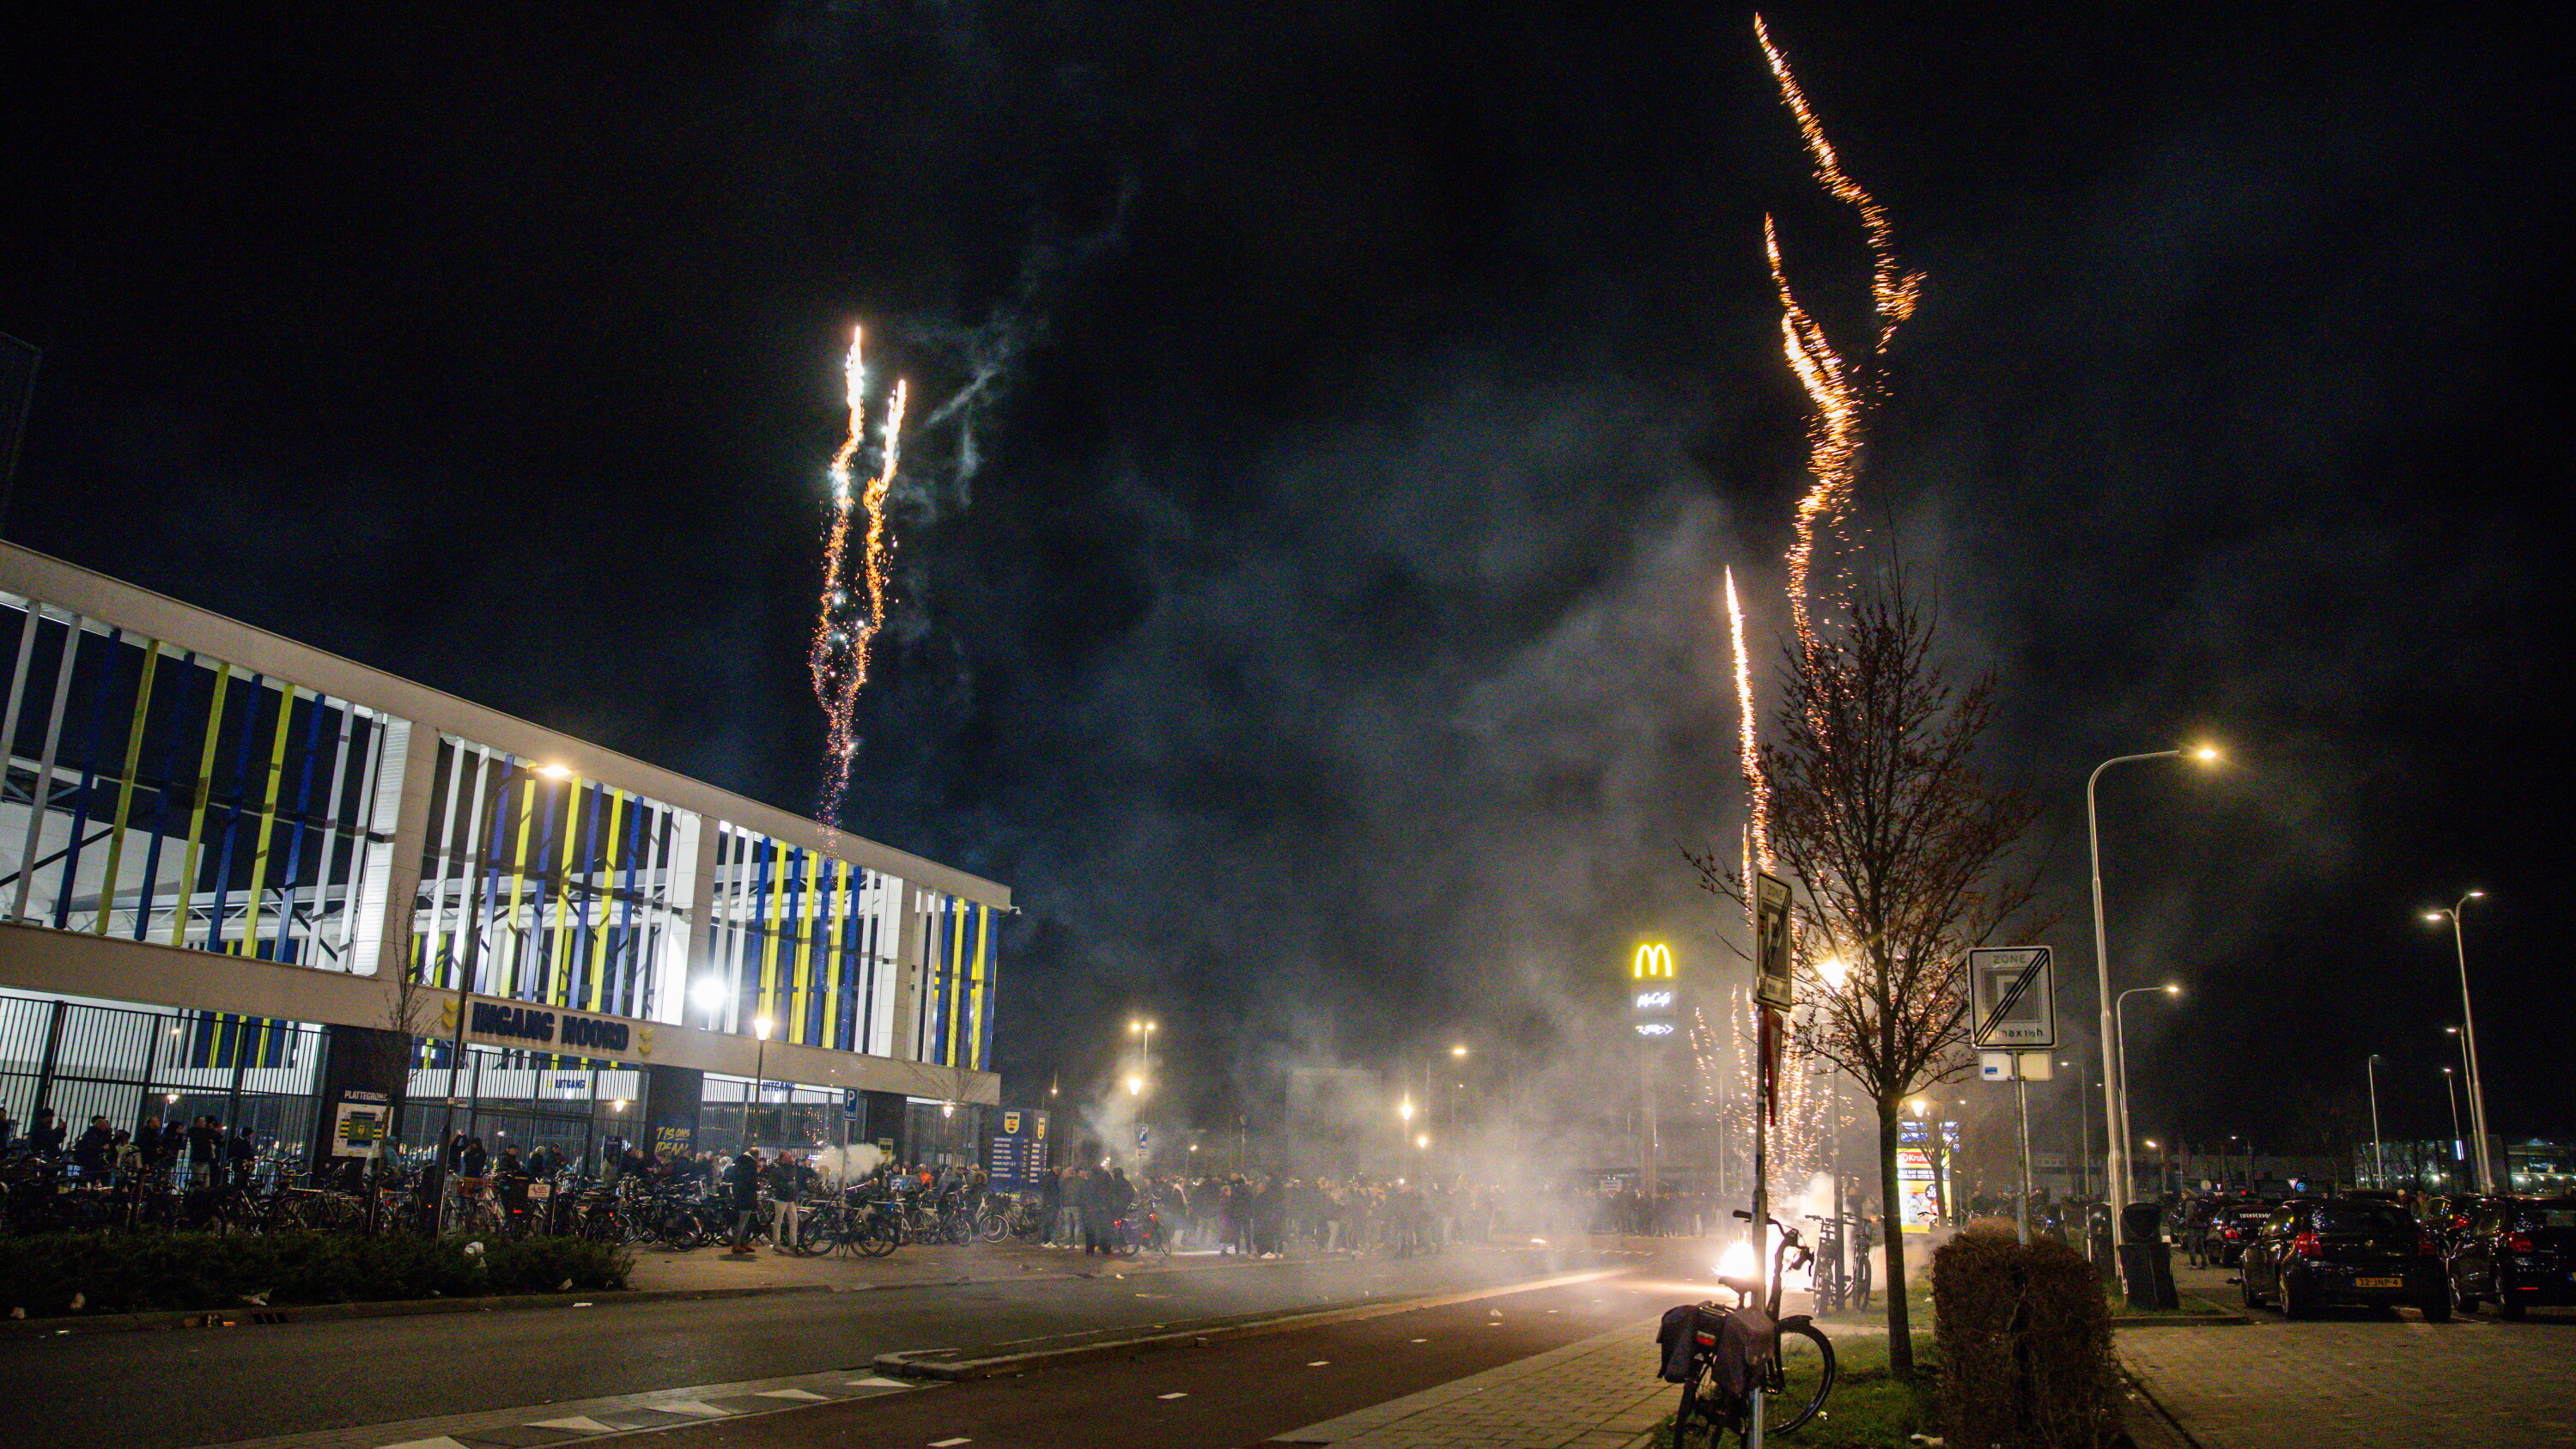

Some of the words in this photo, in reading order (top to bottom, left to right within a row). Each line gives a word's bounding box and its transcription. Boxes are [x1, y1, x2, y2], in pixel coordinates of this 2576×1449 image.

[1992, 954, 2026, 964] ZONE
[471, 1002, 556, 1042] INGANG
[561, 1014, 629, 1051] NOORD
[555, 1079, 586, 1089] UITGANG
[762, 1081, 796, 1093] UITGANG
[847, 1090, 855, 1106] P
